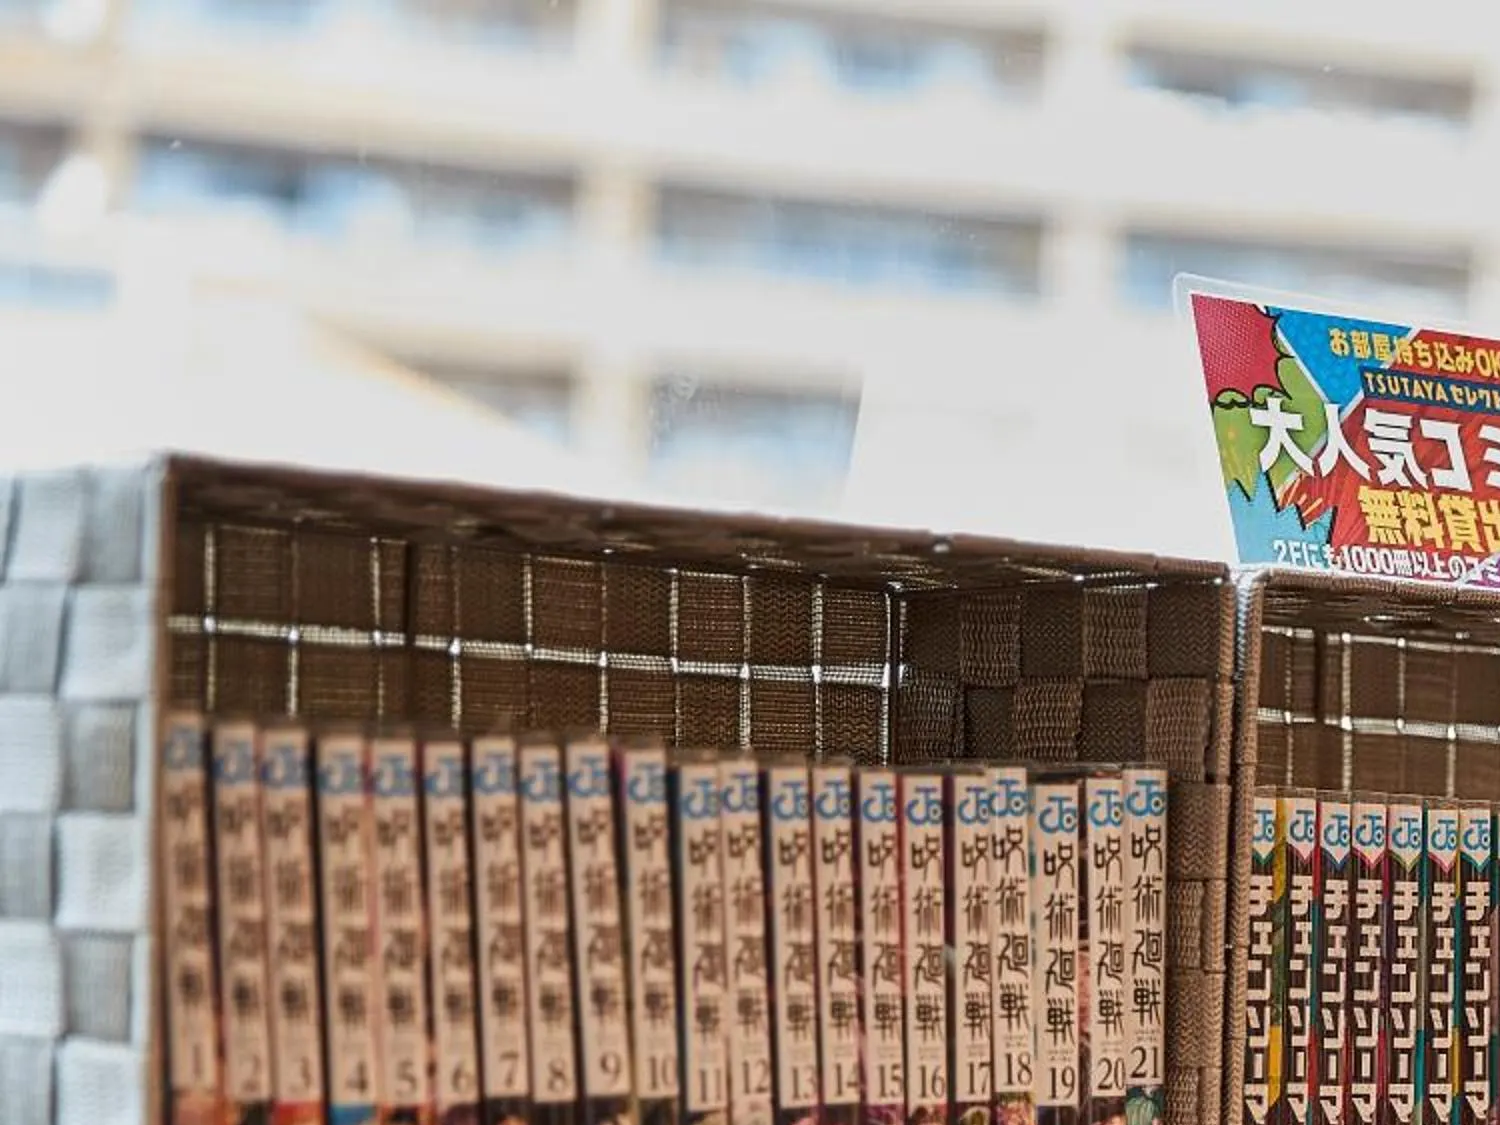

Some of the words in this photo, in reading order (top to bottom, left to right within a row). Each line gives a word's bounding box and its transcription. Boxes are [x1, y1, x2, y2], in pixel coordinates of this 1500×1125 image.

[1364, 372, 1449, 402] TSUTAYA
[779, 832, 815, 1039] 呪術廻戦
[821, 829, 857, 1040] 呪術廻戦
[868, 831, 901, 1042] 呪術廻戦
[911, 833, 945, 1041] 呪術廻戦
[962, 834, 991, 1043] 呪術廻戦
[992, 825, 1029, 1032] 呪術廻戦
[1044, 841, 1075, 1046] 呪術廻戦
[1094, 836, 1125, 1037] 呪術廻戦
[1131, 825, 1162, 1027] 呪術廻戦
[348, 1060, 368, 1094] 4
[395, 1060, 417, 1094] 5
[451, 1058, 471, 1094] 6
[501, 1052, 520, 1087] 7
[547, 1060, 567, 1092] 8
[600, 1051, 621, 1087] 9
[648, 1056, 677, 1090] 10
[741, 1060, 769, 1095] 12
[834, 1062, 858, 1098] 14
[877, 1063, 902, 1098] 15
[967, 1060, 990, 1095] 17
[1005, 1050, 1032, 1086] 18
[1098, 1057, 1125, 1090] 20
[1131, 1047, 1160, 1079] 21
[792, 1067, 815, 1100] 13
[919, 1064, 945, 1098] 16
[1050, 1066, 1075, 1100] 19
